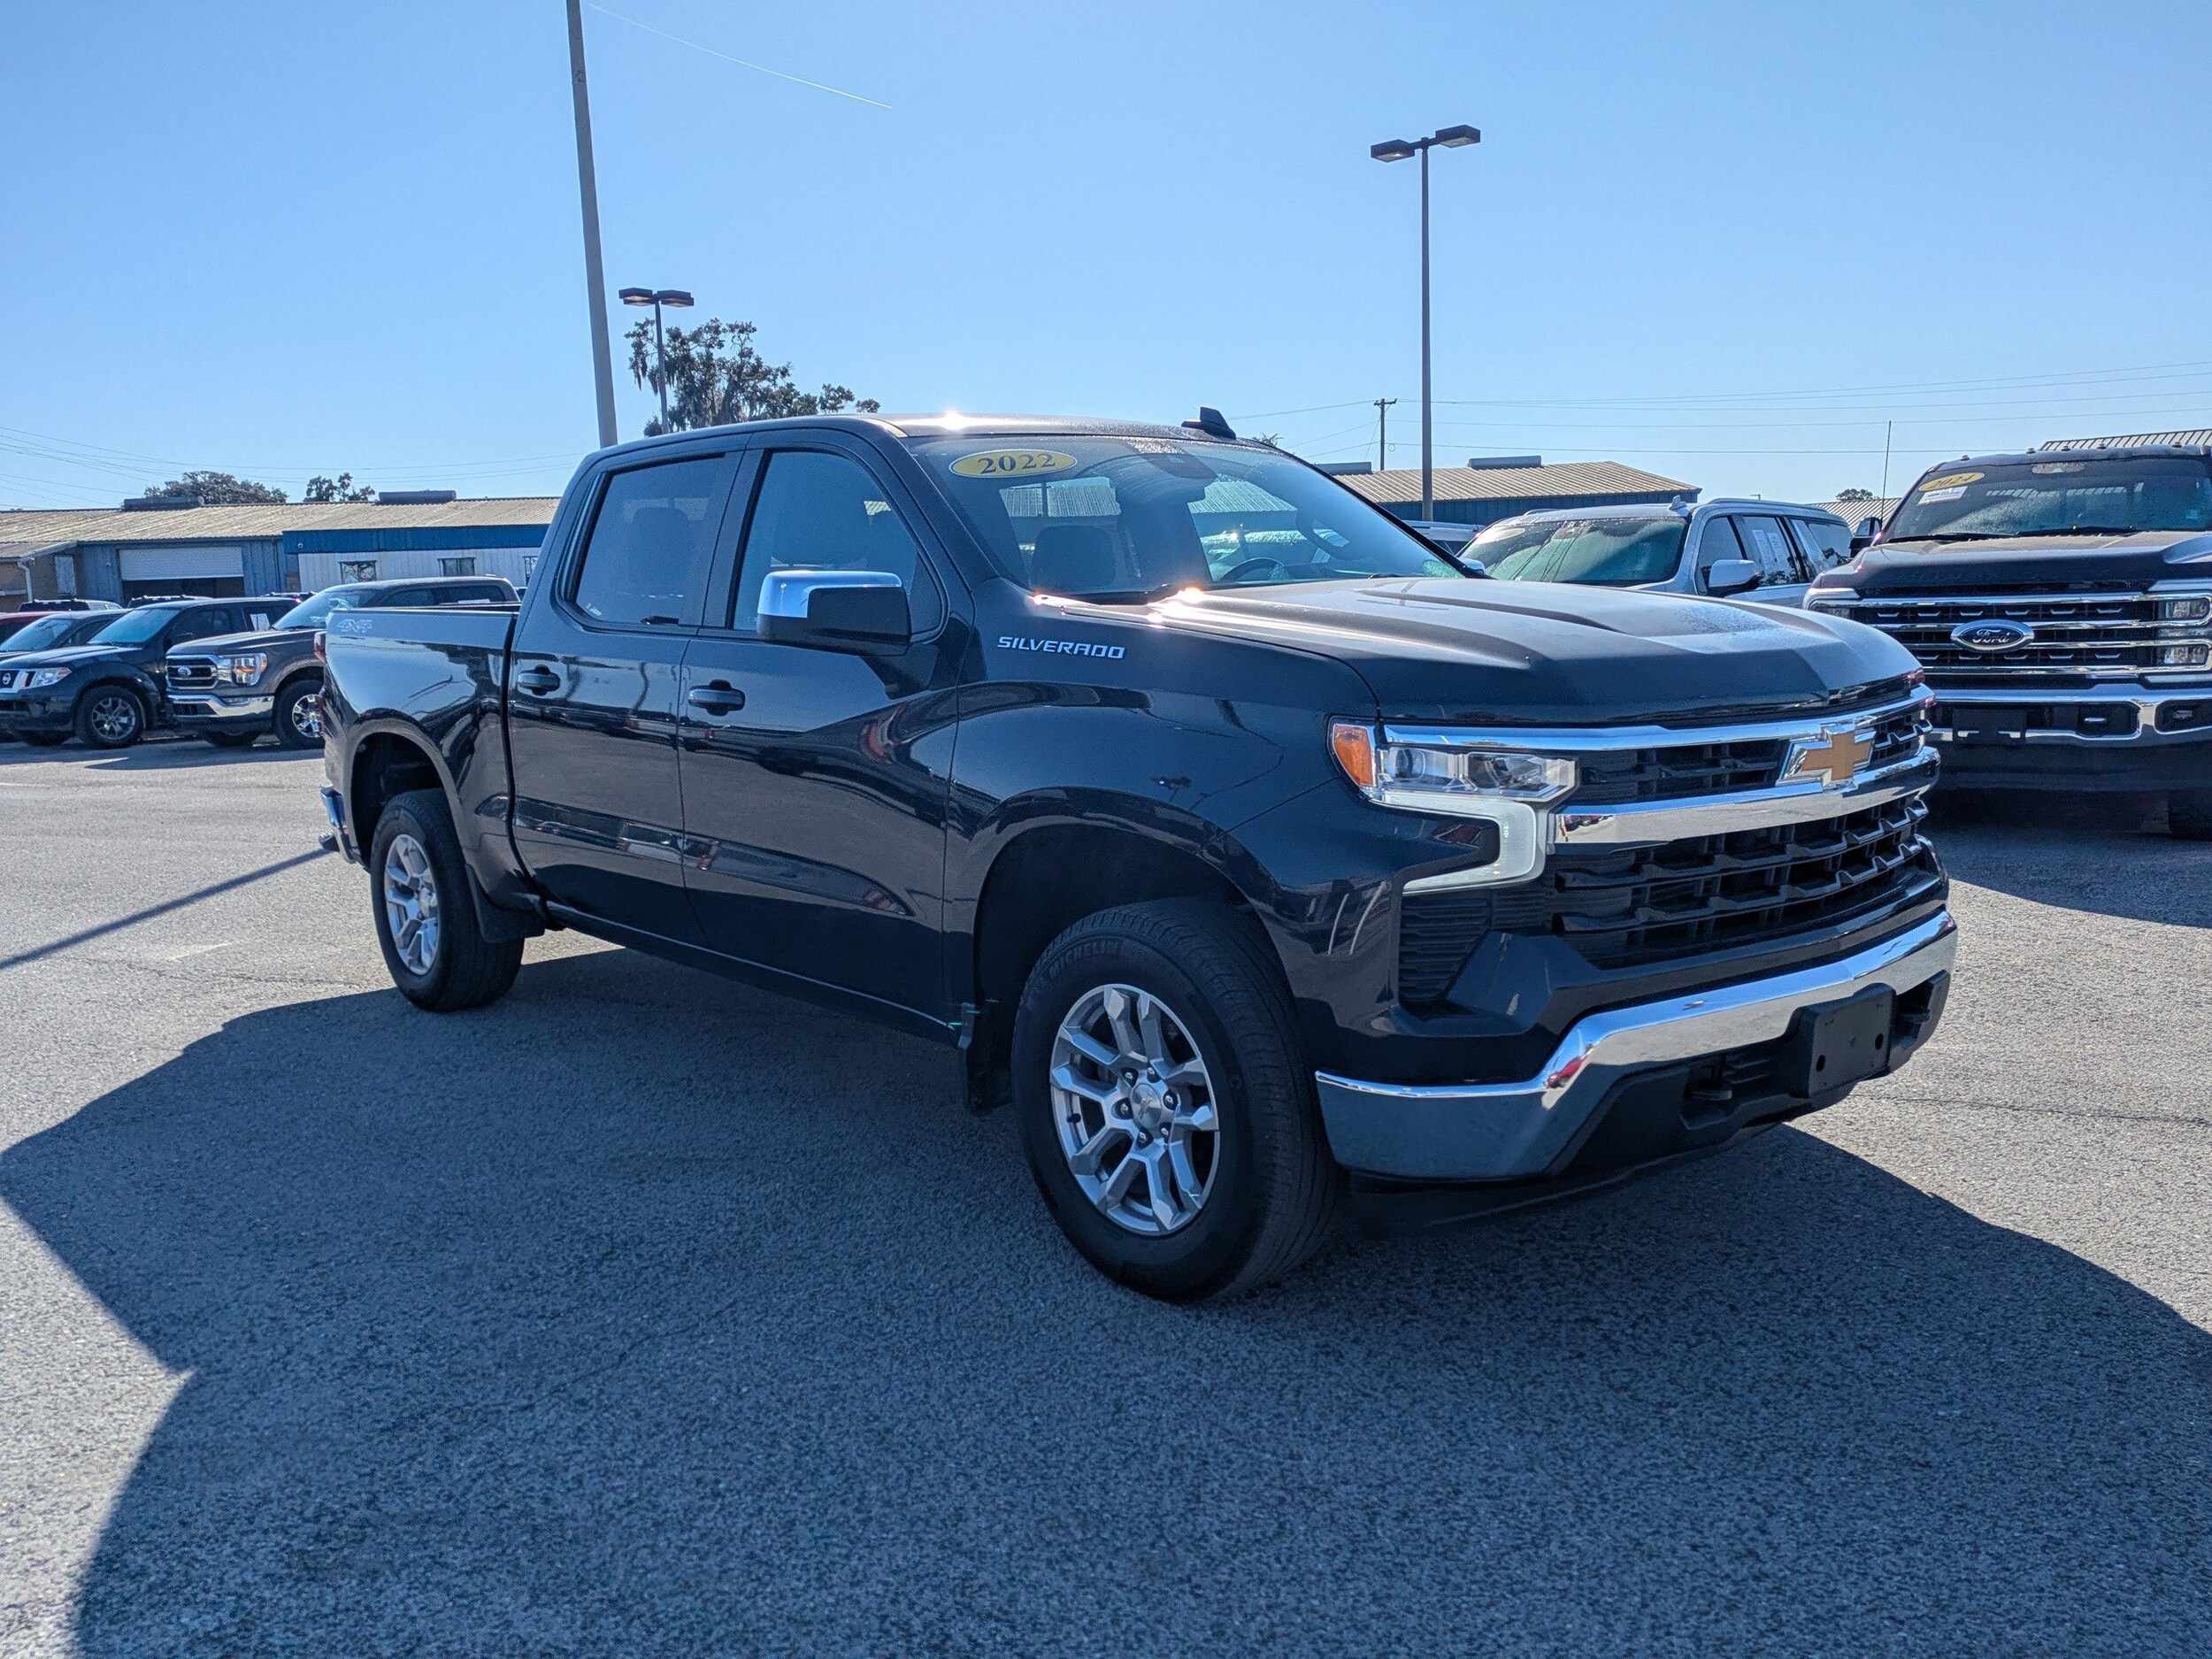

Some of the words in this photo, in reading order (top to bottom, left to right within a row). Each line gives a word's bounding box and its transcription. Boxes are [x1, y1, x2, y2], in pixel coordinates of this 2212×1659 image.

[978, 452, 1056, 474] 2022
[1971, 628, 2010, 644] Ford
[997, 636, 1125, 659] SILVERADO
